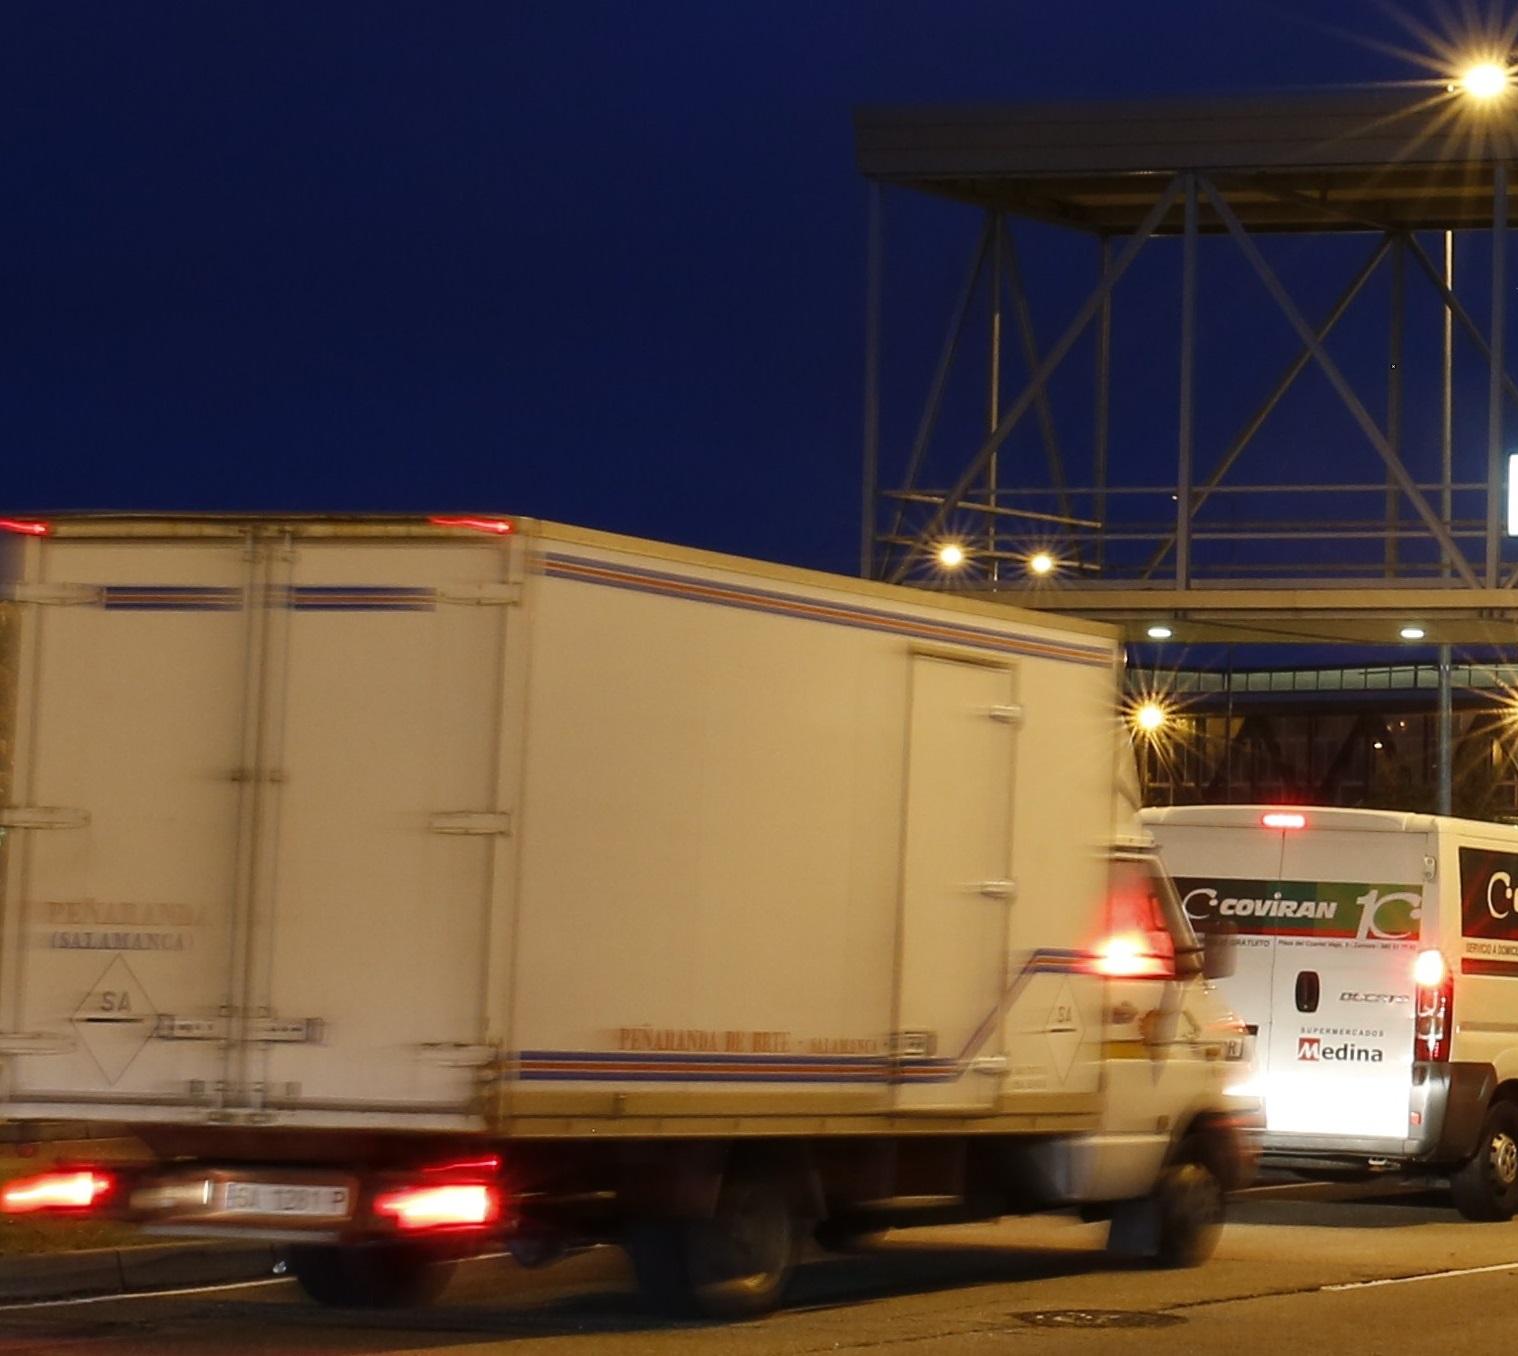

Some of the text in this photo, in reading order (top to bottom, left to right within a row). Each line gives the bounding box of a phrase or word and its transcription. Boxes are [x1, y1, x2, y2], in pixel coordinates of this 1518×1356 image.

[101, 991, 133, 1012] SA
[1301, 1026, 1384, 1037] SUPERMERCADOS
[1298, 1038, 1383, 1062] Medina
